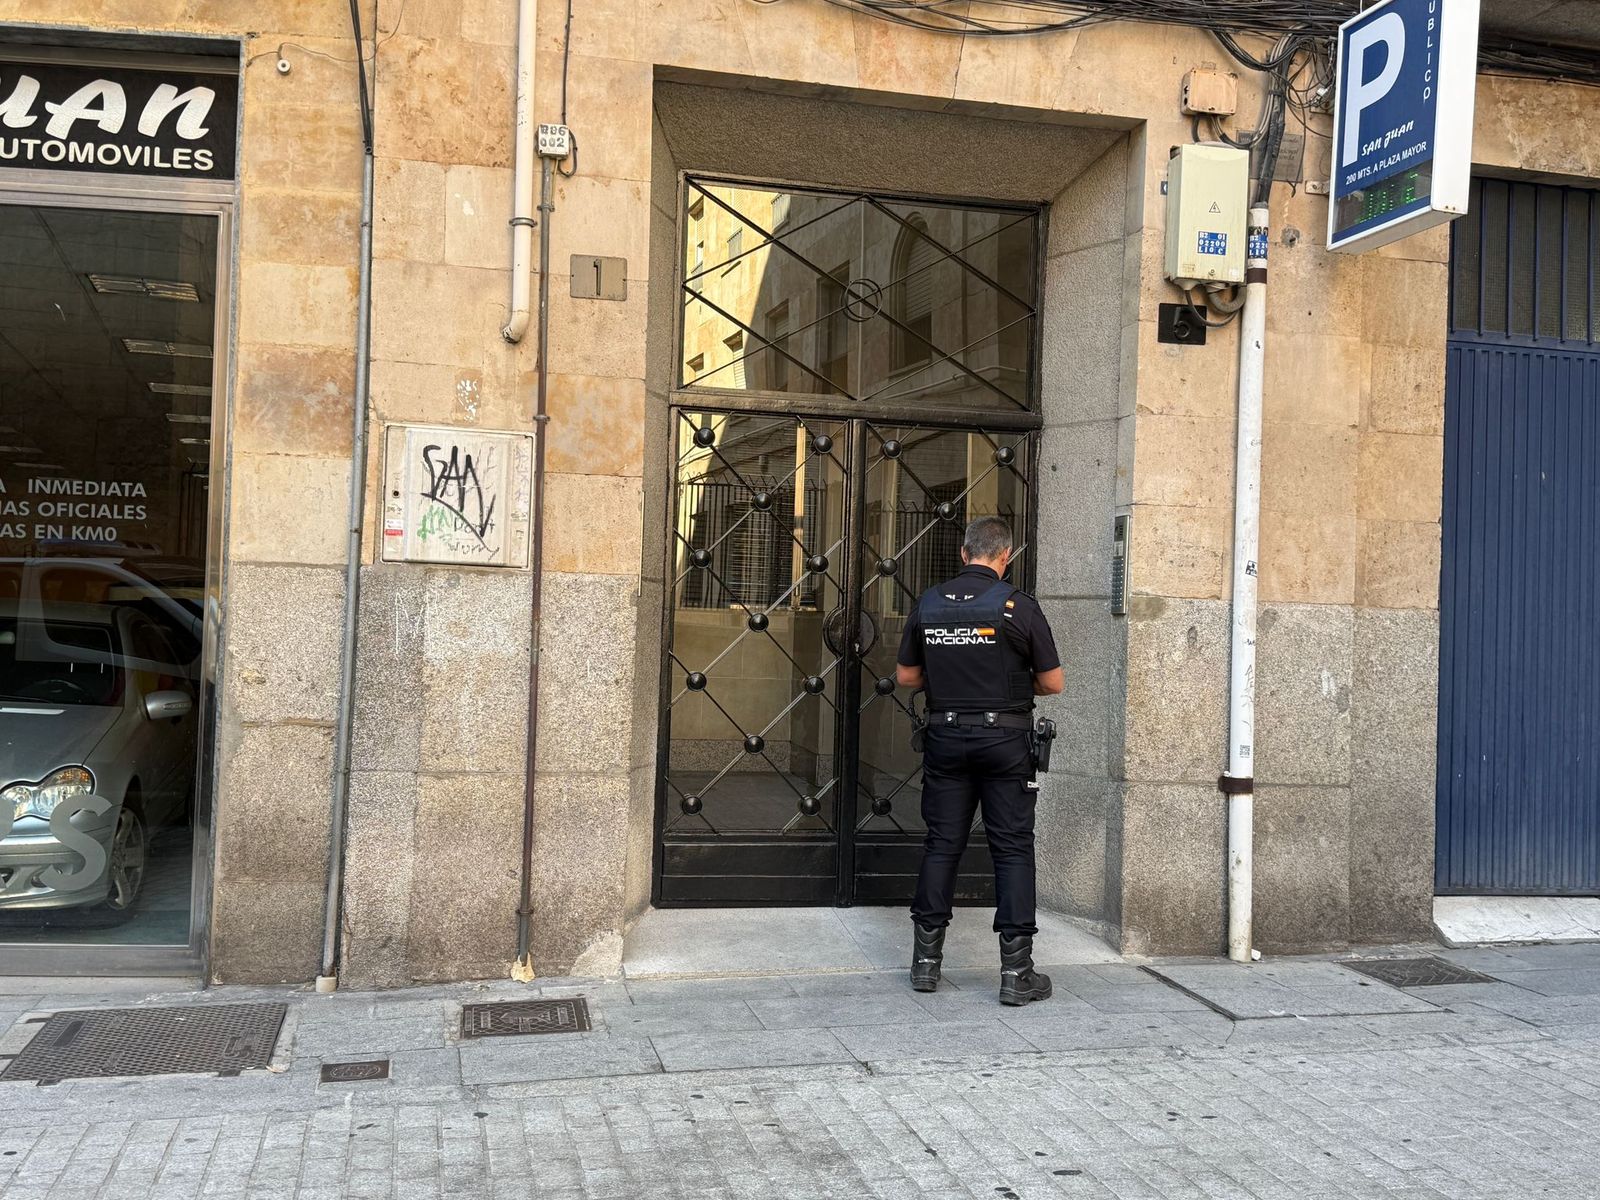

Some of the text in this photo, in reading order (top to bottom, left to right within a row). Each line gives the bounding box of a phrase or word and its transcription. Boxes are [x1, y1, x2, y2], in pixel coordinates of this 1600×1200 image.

[1343, 12, 1406, 168] P
[1346, 173, 1357, 185] 200
[1373, 162, 1380, 173] A
[1379, 152, 1401, 170] PLAZA
[1401, 141, 1428, 160] MAYOR
[1199, 239, 1226, 247] 02200
[593, 258, 603, 297] 1
[28, 479, 147, 497] INMEDIATA
[37, 502, 147, 520] OFICIALES
[35, 524, 63, 540] EN
[927, 636, 995, 645] NACIONAL
